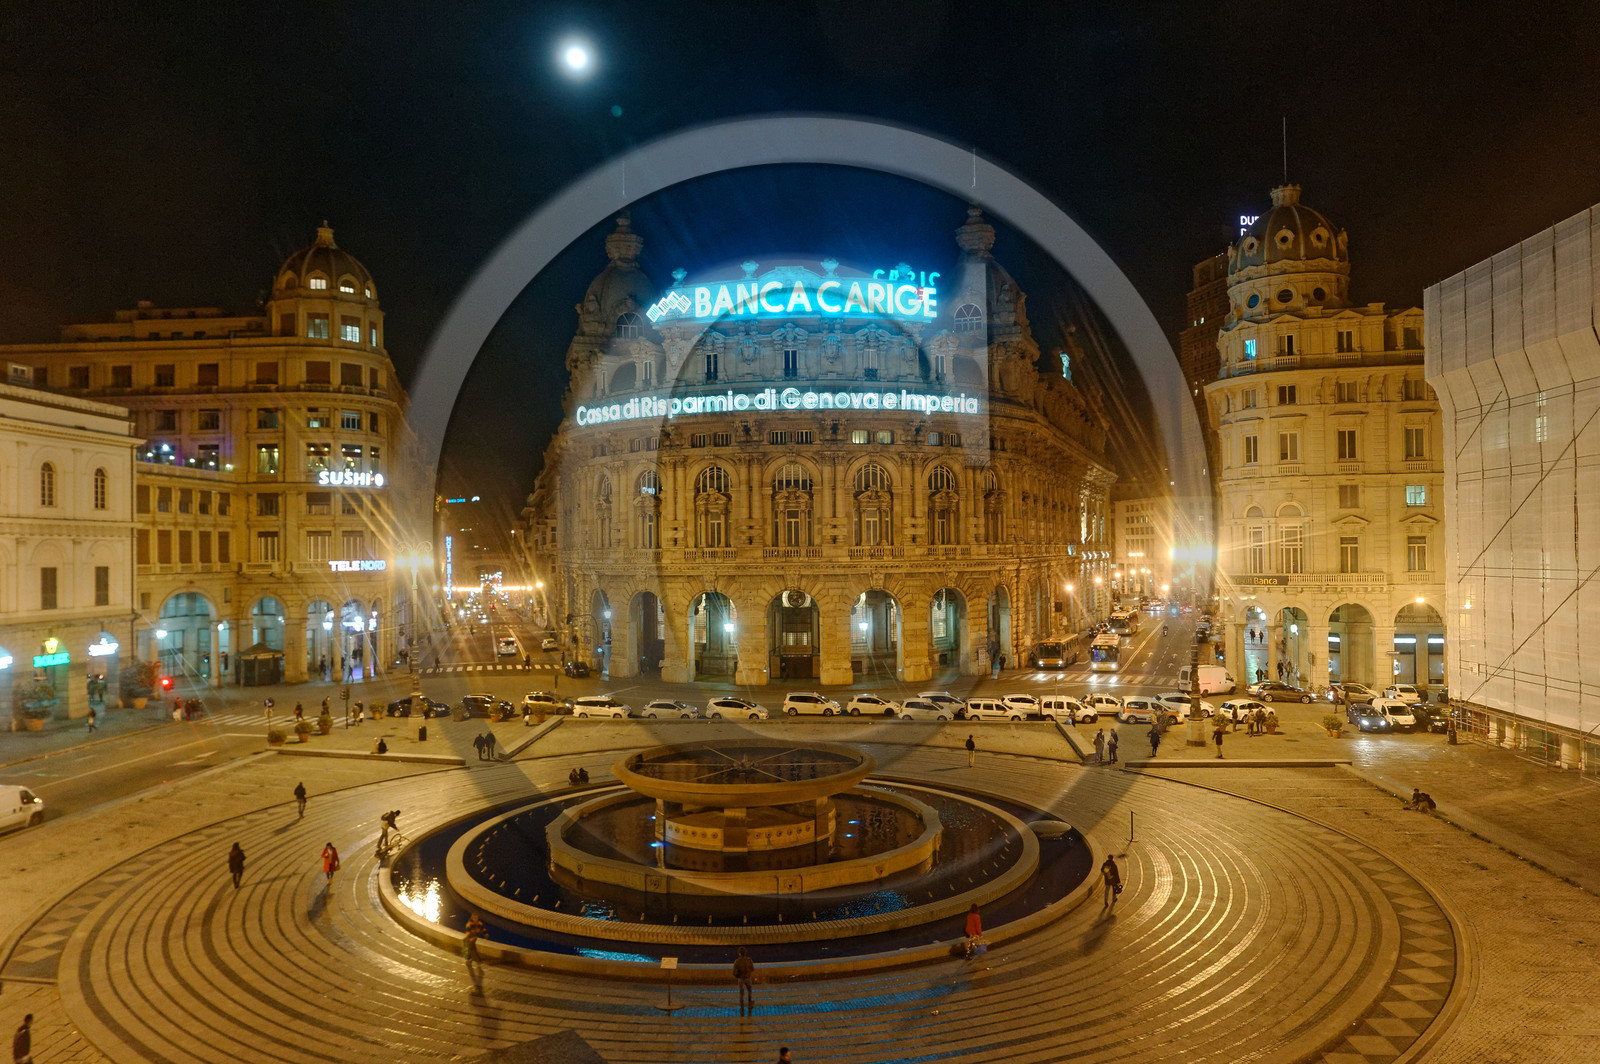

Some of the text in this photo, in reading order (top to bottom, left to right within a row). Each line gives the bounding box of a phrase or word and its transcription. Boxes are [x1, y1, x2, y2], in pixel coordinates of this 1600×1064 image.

[694, 280, 938, 318] BANCA CARIGE
[576, 387, 978, 426] Cassa di Risparmio di Genova e Imperia
[1253, 576, 1278, 585] Banca
